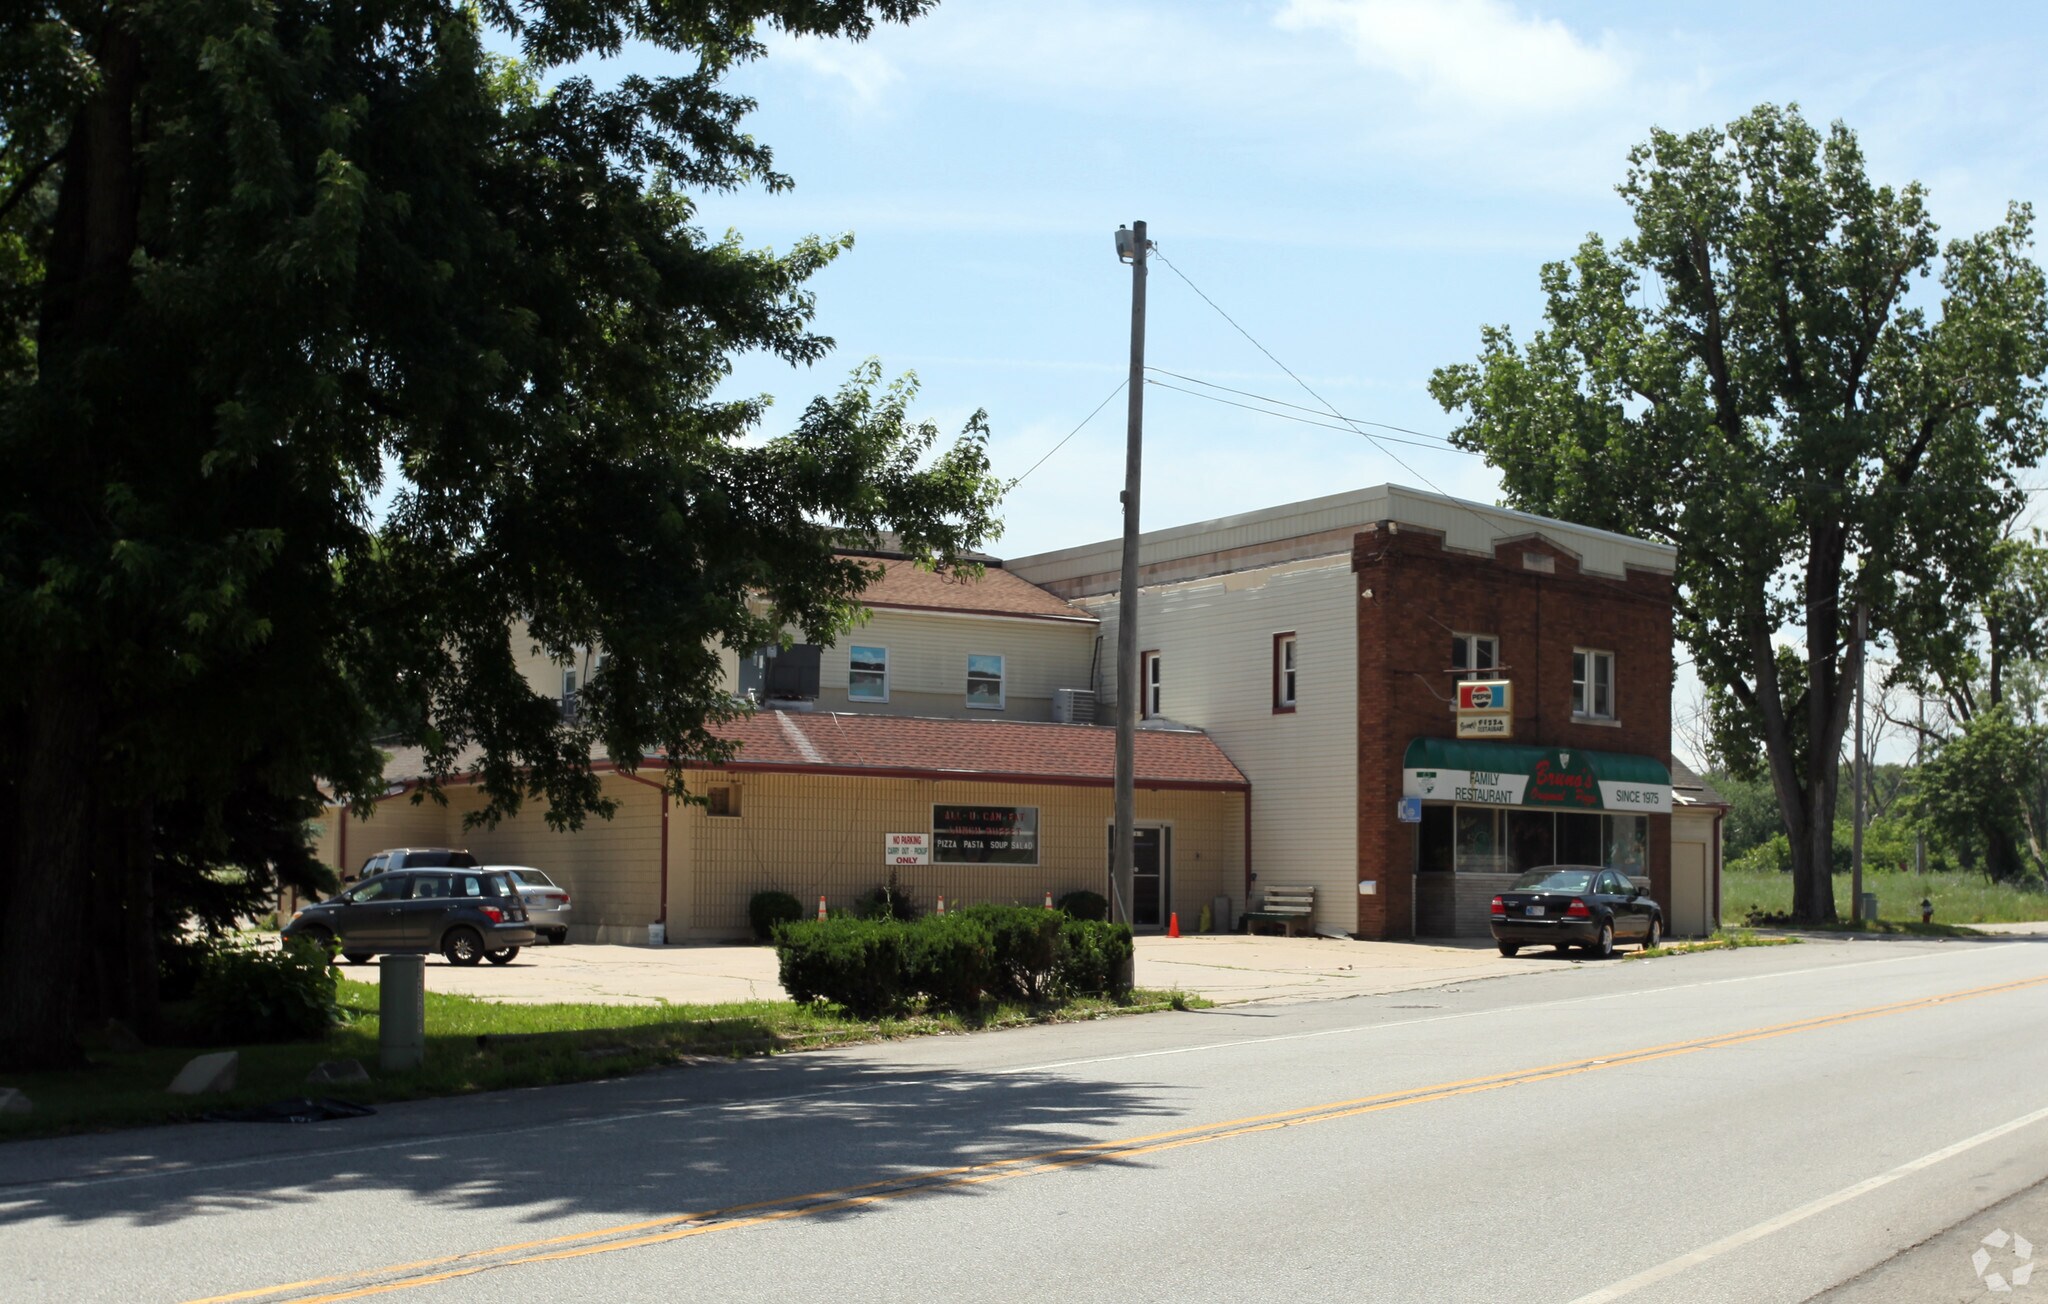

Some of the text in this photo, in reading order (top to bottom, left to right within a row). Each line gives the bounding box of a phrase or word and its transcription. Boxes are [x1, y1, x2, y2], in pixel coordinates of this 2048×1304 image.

[1470, 771, 1499, 786] FAMILY
[1536, 760, 1593, 789] Bruno's
[1455, 787, 1512, 803] RESTAURANT
[1616, 789, 1659, 804] SINCE 1975
[944, 811, 961, 820] ALL
[983, 812, 1002, 821] CAN
[893, 836, 921, 844] NO PARKING
[937, 840, 1033, 850] PIZZA PASTA SOUP SALAD
